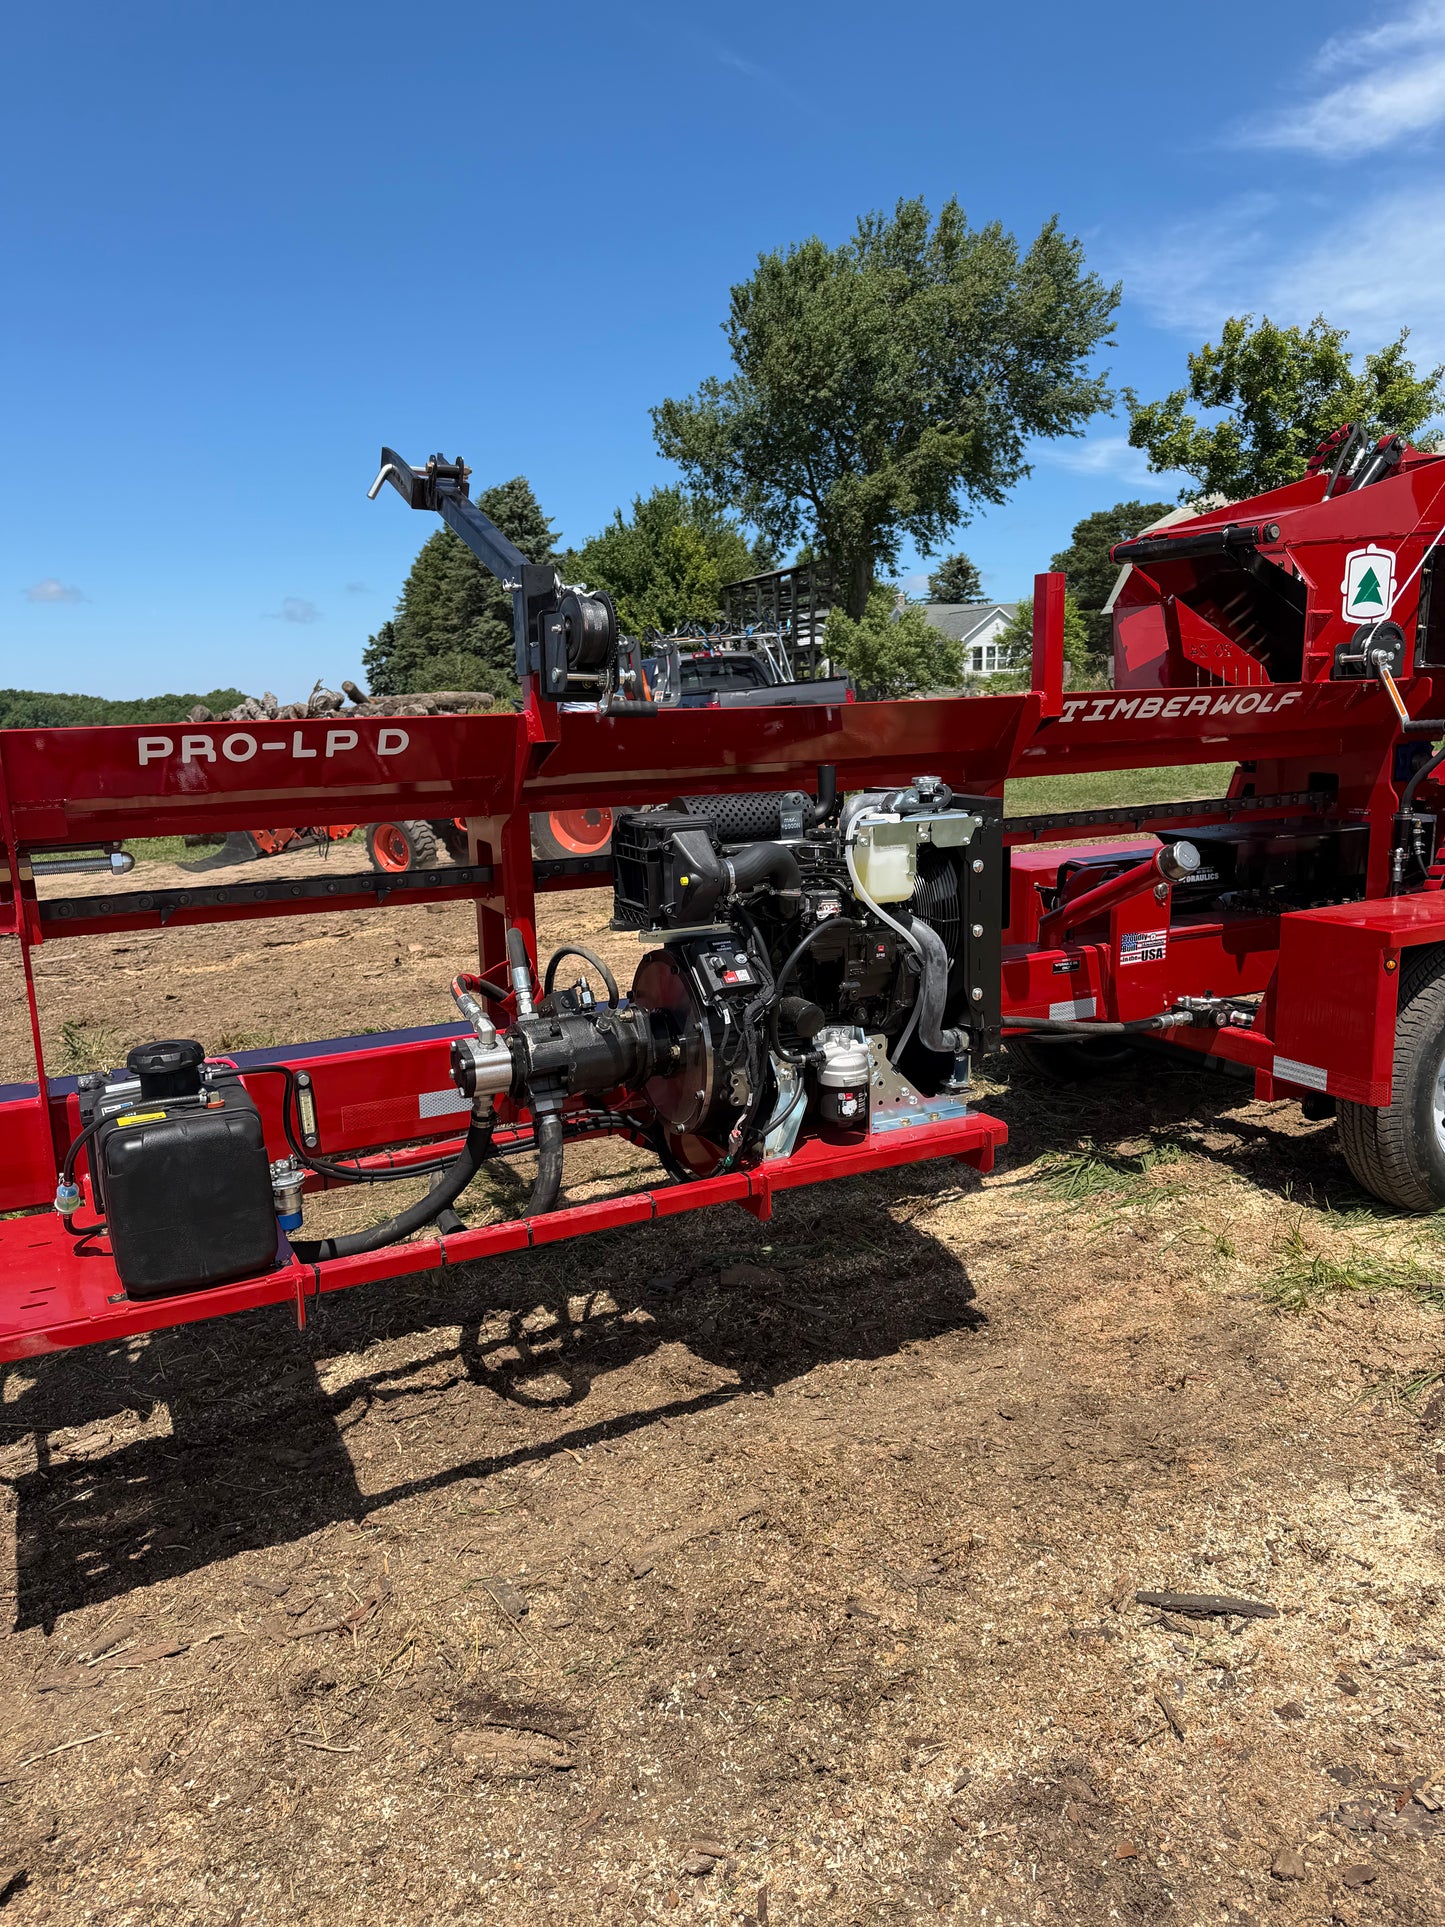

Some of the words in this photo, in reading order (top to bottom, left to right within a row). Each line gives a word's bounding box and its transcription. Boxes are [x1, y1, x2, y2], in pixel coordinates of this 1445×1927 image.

[1058, 691, 1303, 723] TIMBERWOLF
[138, 729, 359, 766] PRO-LP
[377, 728, 410, 756] D
[1183, 872, 1220, 884] DRAULICS
[1121, 932, 1148, 942] Proudly
[1141, 947, 1163, 962] USA
